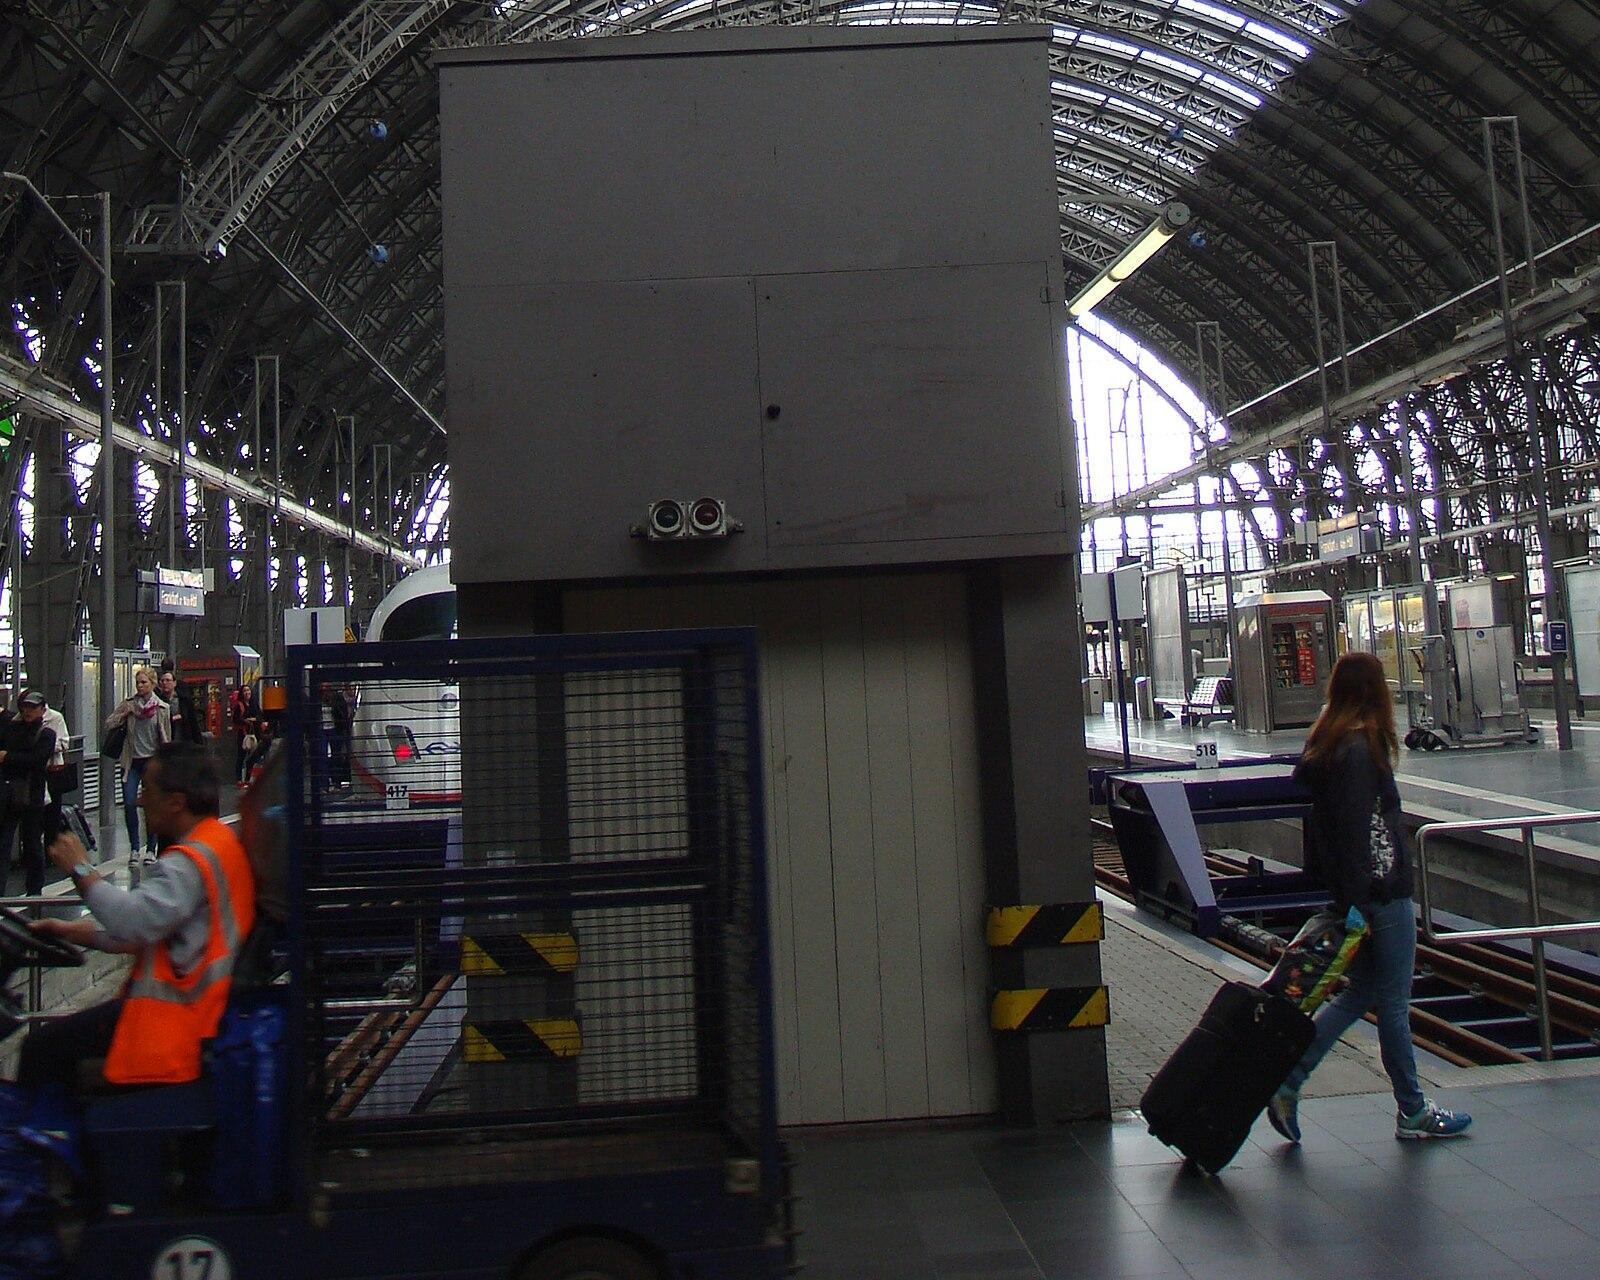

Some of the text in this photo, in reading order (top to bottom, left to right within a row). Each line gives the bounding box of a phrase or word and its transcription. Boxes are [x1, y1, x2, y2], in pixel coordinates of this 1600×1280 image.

[1196, 744, 1217, 757] 518
[387, 785, 408, 798] 417
[166, 1250, 215, 1280] 17
